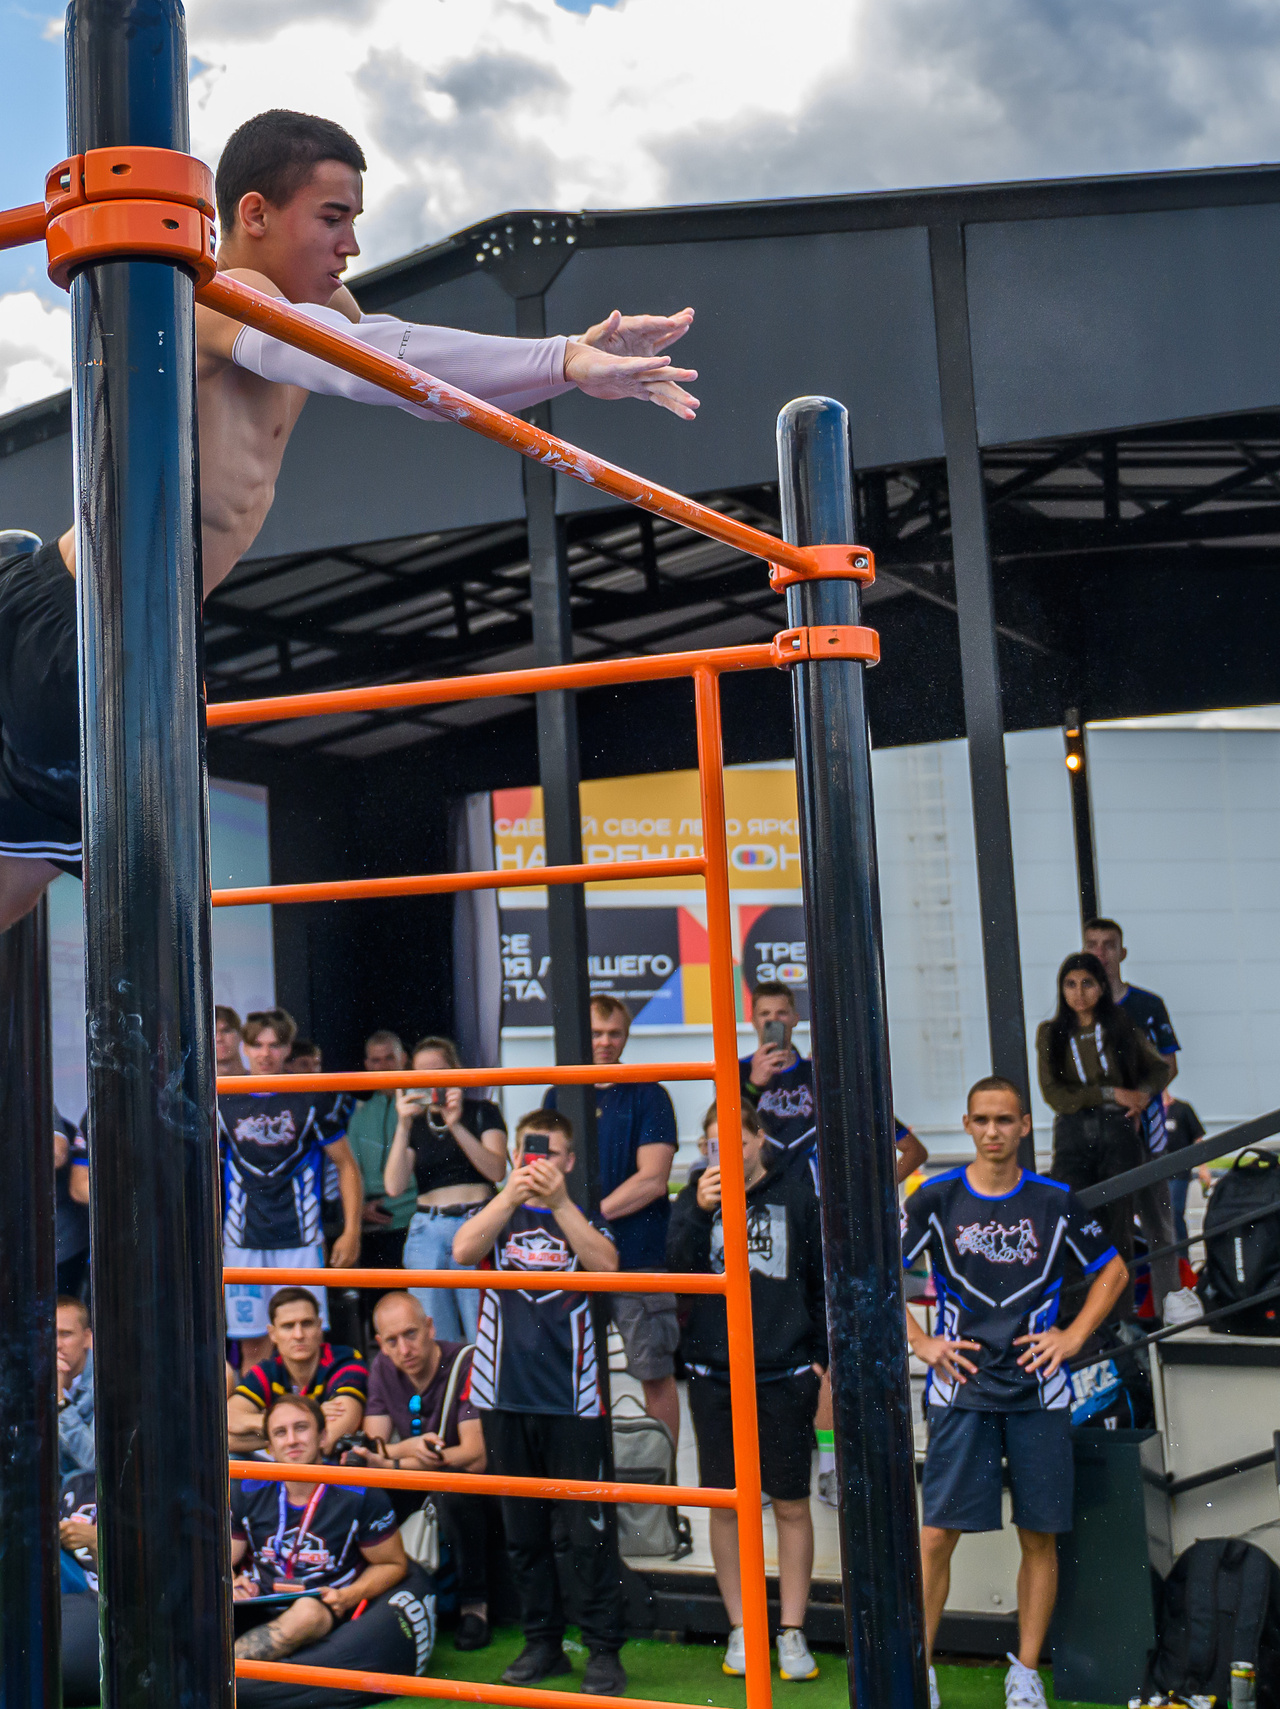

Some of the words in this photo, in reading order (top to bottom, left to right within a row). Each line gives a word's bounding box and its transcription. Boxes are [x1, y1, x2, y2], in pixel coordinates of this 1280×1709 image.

[494, 816, 598, 837] СДЕЙ
[603, 818, 671, 836] СВОЕ
[678, 818, 741, 836] ЛЕО
